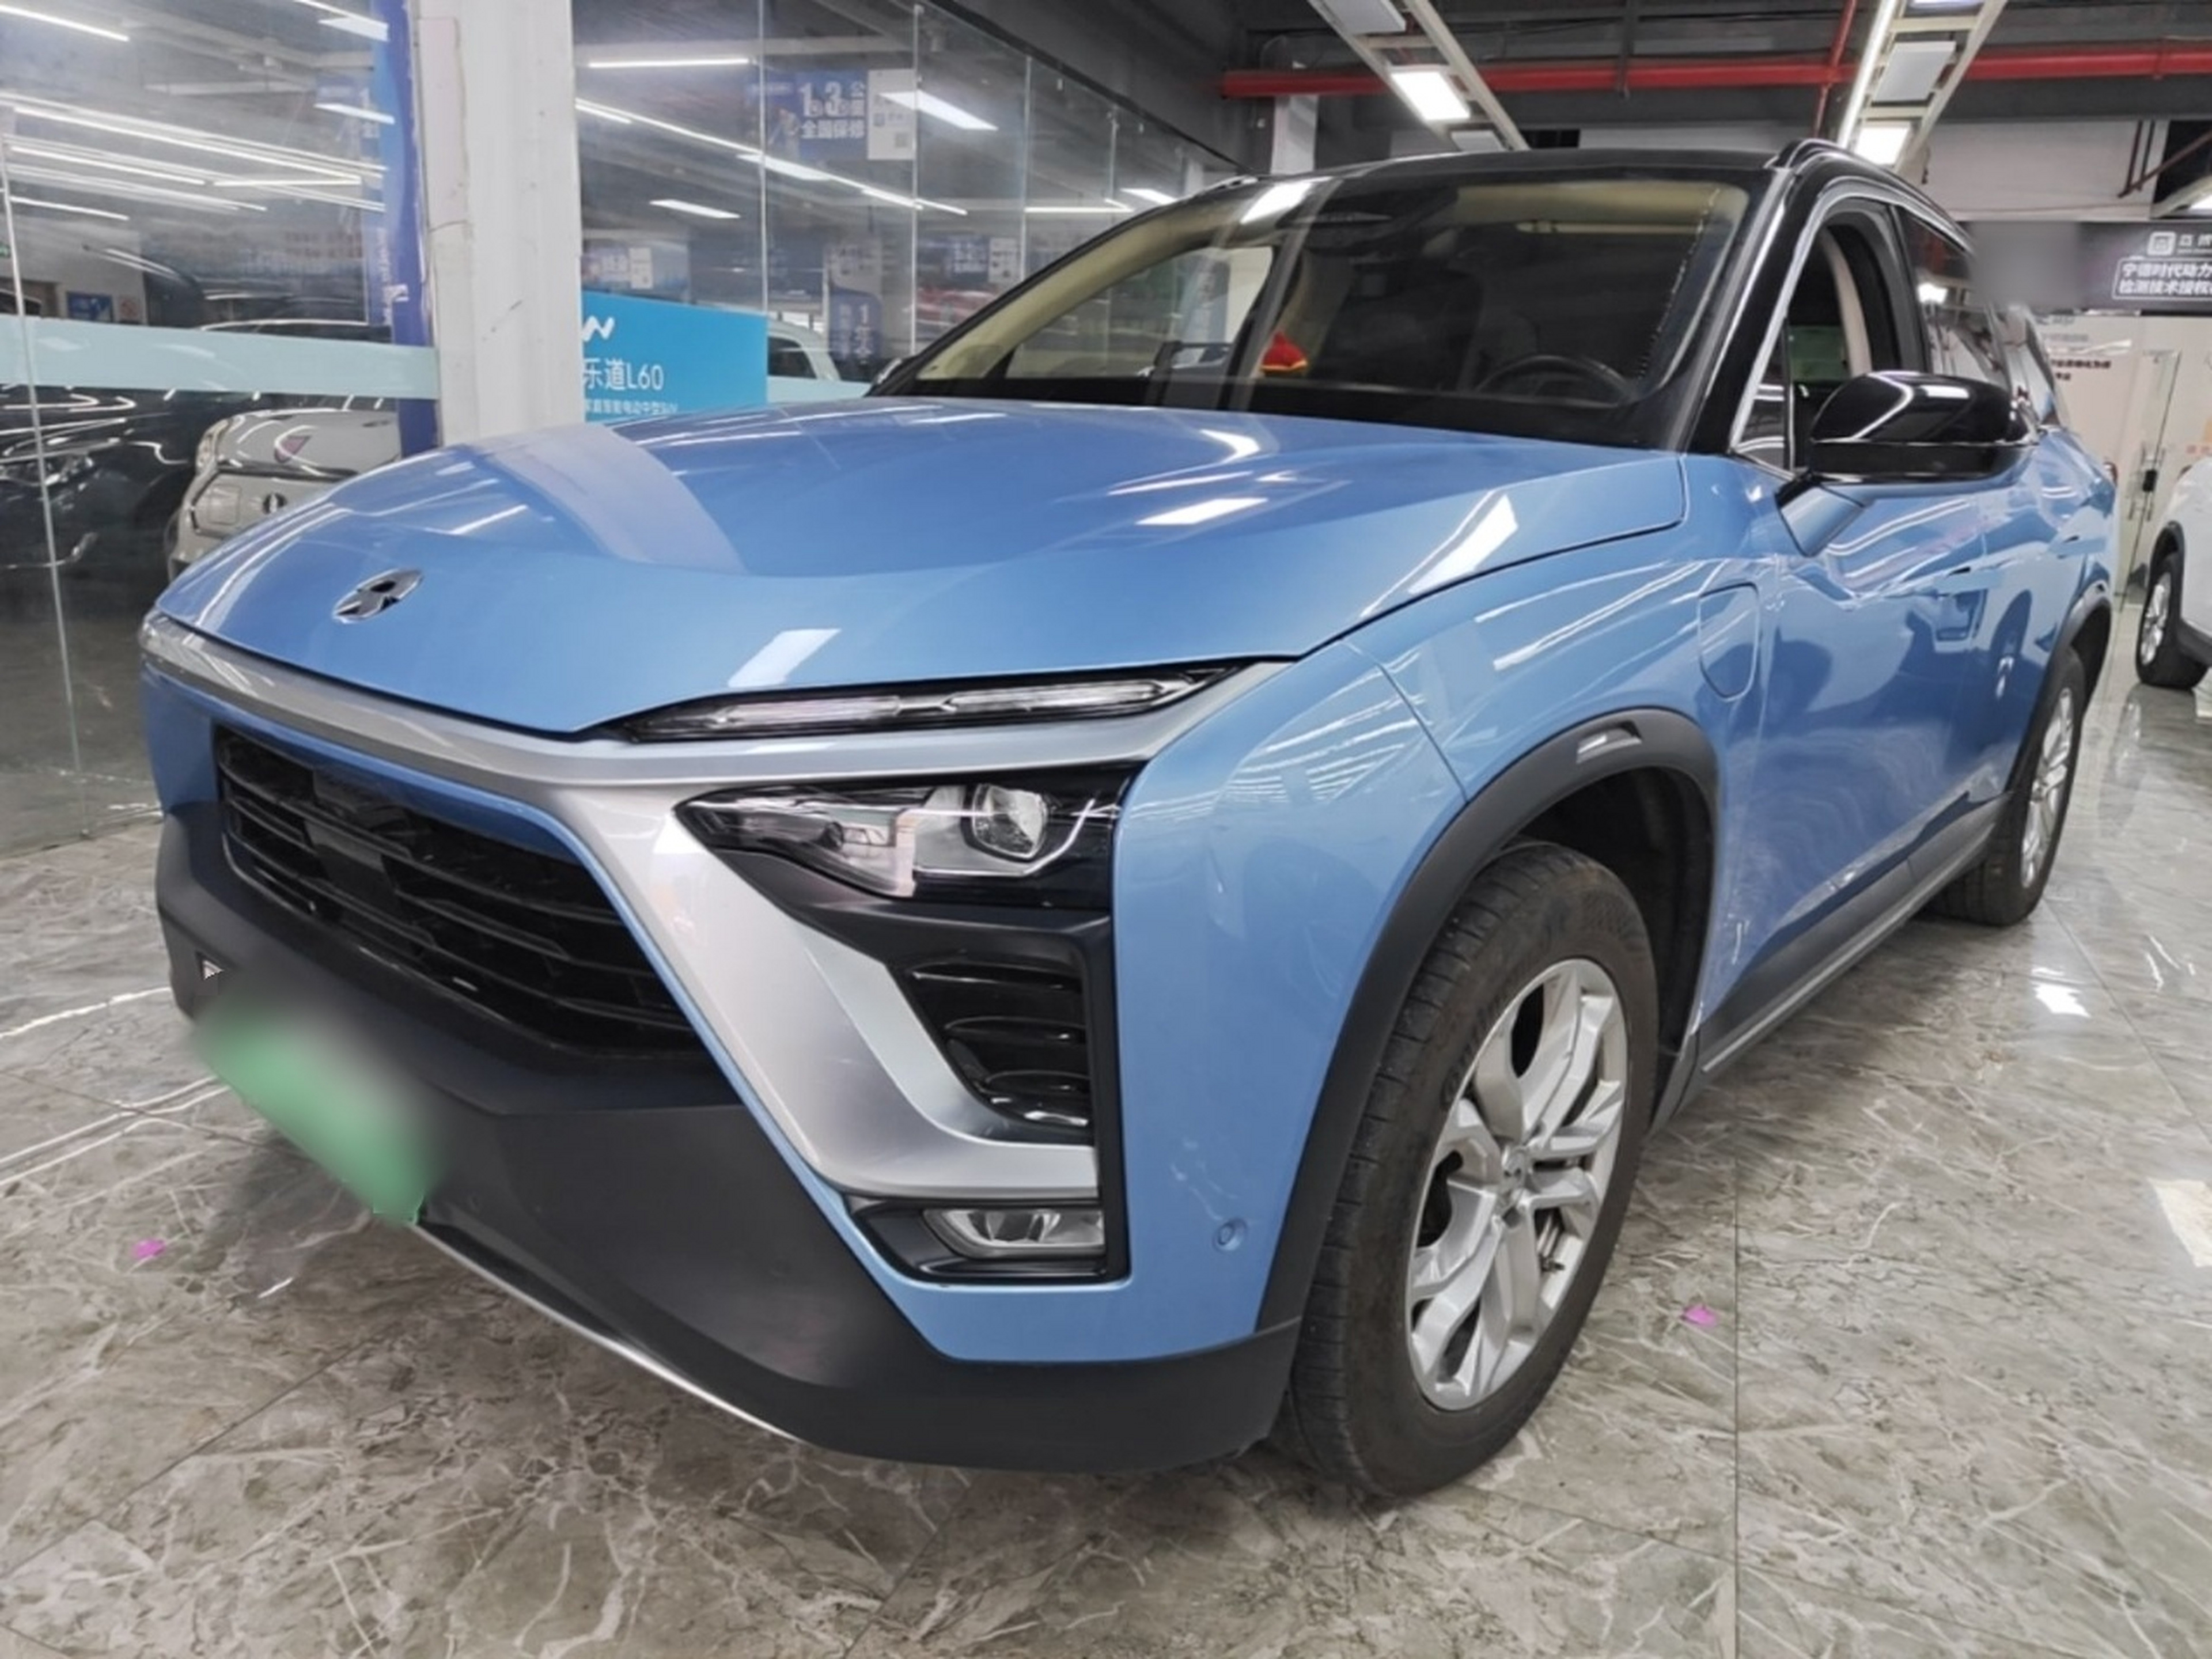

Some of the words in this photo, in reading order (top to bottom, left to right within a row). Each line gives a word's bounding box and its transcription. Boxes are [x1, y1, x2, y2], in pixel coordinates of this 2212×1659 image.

[2119, 279, 2212, 295] 检测技术授权
[582, 357, 664, 391] 乐道L60
